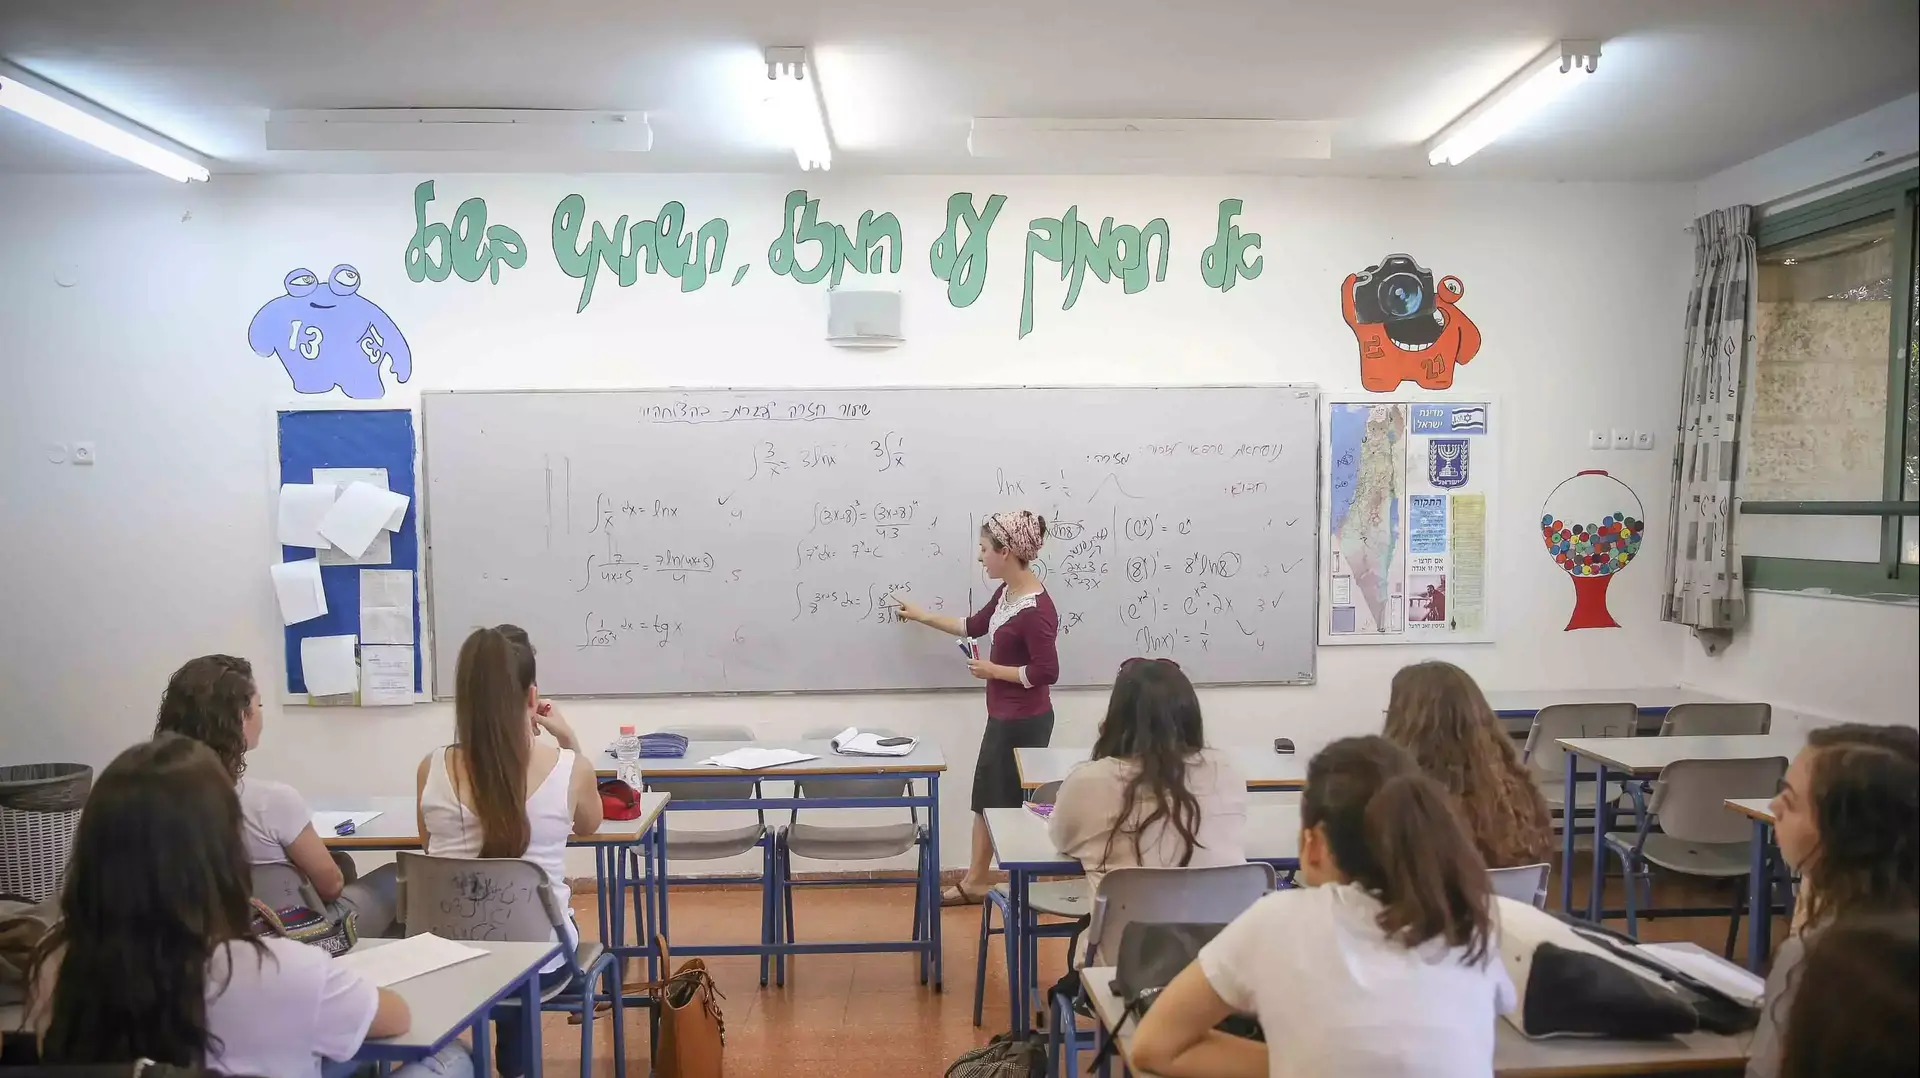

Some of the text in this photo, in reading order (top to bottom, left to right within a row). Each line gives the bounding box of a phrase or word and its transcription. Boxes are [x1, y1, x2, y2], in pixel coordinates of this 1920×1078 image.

[405, 180, 528, 285] בשכל
[930, 192, 1007, 308] על
[1201, 199, 1263, 292] אל
[552, 194, 729, 314] תשתמש
[288, 320, 324, 361] 13
[1417, 420, 1443, 430] ישראל
[1419, 408, 1444, 418] מדינת
[1436, 476, 1460, 486] ישראל
[1413, 498, 1442, 508] התקוה
